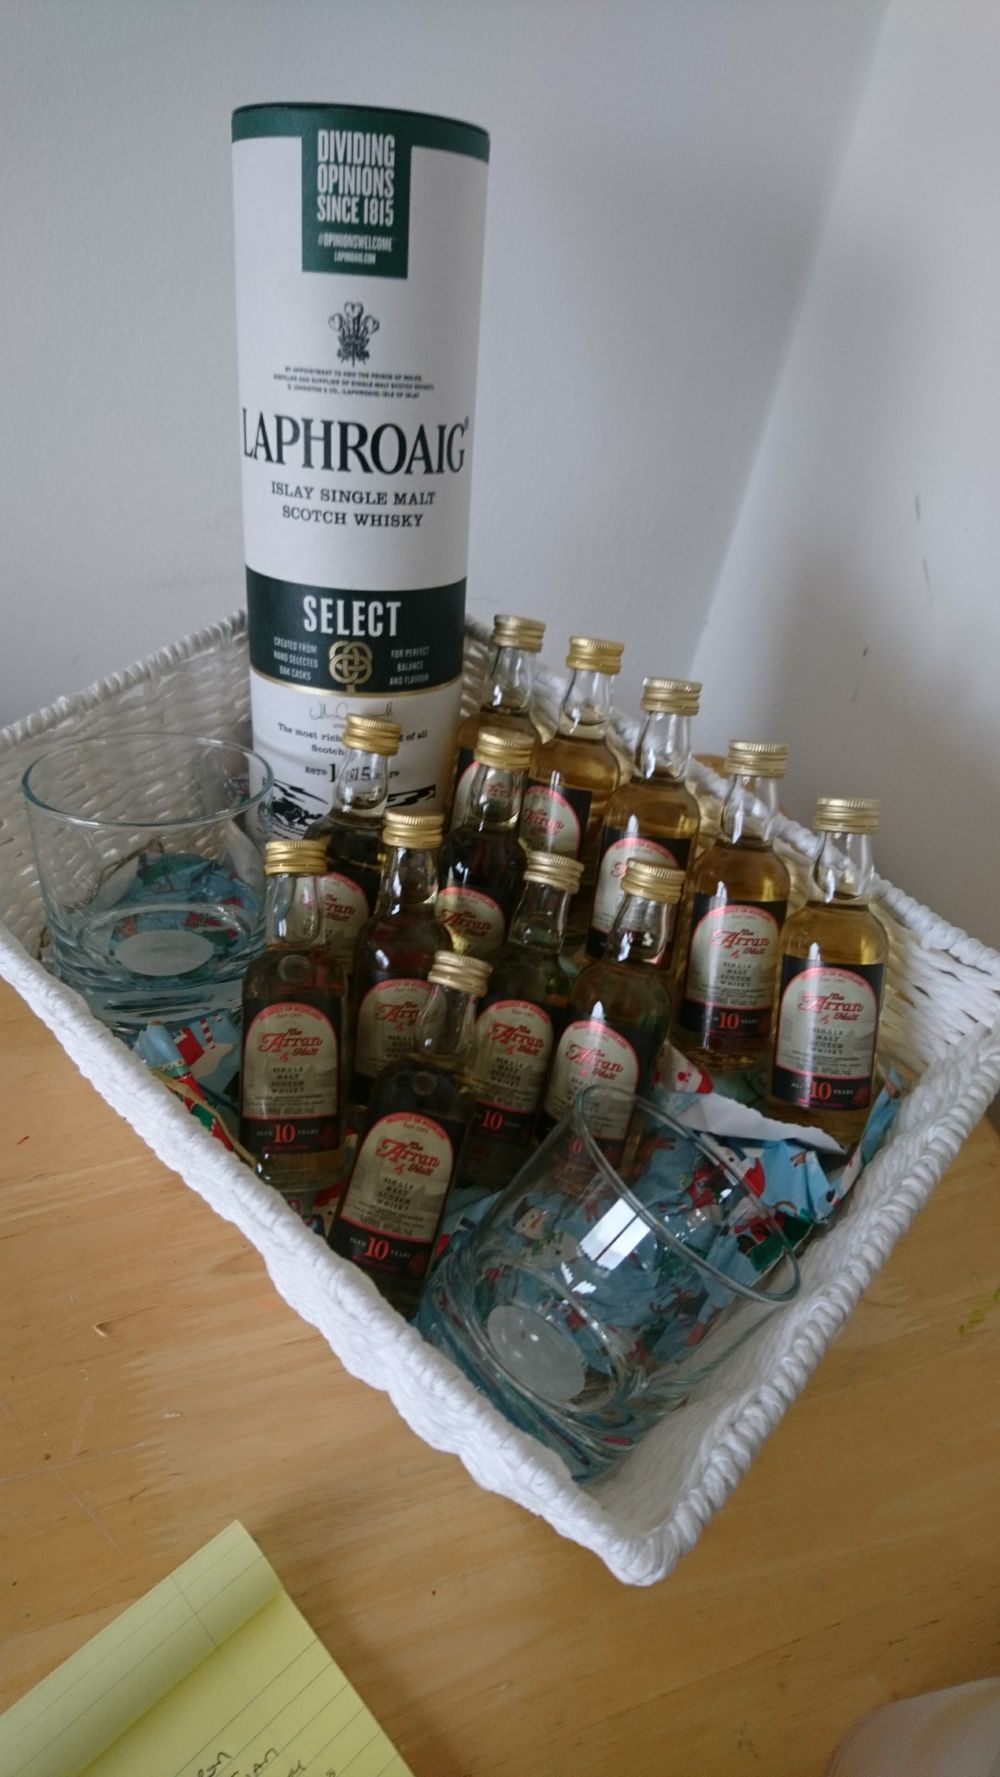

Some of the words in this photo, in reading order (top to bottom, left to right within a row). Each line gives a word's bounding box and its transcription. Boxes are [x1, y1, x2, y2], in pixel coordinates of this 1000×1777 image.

[317, 129, 395, 166] DIVIDING
[317, 164, 395, 198] OPINIONS
[317, 195, 359, 225] SINCE
[363, 198, 394, 226] 1815
[318, 232, 392, 252] #OPINIONSWELCOME
[242, 408, 466, 475] LAPHROAIG
[271, 481, 314, 499] ISLAY
[320, 487, 388, 506] SINGLE
[393, 491, 436, 505] MALT
[282, 504, 347, 525] SCOTCH
[354, 513, 424, 528] WHISKY
[303, 595, 401, 637] SELECT
[273, 636, 298, 651] CREATED
[299, 642, 317, 654] FROM
[391, 649, 404, 658] FOR
[405, 646, 430, 658] PERFECT
[273, 650, 288, 663] HAND
[289, 653, 319, 669] SELECTED
[397, 661, 424, 673] BALANCE
[279, 665, 291, 676] OAK
[292, 667, 311, 681] CASKS
[389, 676, 403, 686] AND
[404, 673, 429, 685] FLAVOUR
[278, 722, 293, 734] The
[295, 729, 318, 741] most
[406, 732, 416, 741] of
[417, 730, 428, 740] all
[311, 744, 346, 756] Scotch
[439, 908, 493, 930] Arran
[708, 929, 770, 948] Arran
[741, 928, 754, 937] The
[743, 947, 766, 955] Malt
[797, 992, 864, 1013] Arran
[830, 993, 844, 1001] The
[719, 1012, 740, 1030] 10
[833, 1012, 859, 1021] Malt
[288, 1028, 302, 1036] The
[486, 1022, 545, 1048] Arran
[258, 1032, 323, 1052] Arran
[292, 1047, 320, 1056] Malt
[810, 1081, 832, 1100] 10
[481, 1110, 503, 1130] 10
[273, 1124, 296, 1144] 10
[376, 1138, 440, 1168] Arran
[409, 1140, 424, 1152] The
[364, 1235, 389, 1261] 10
